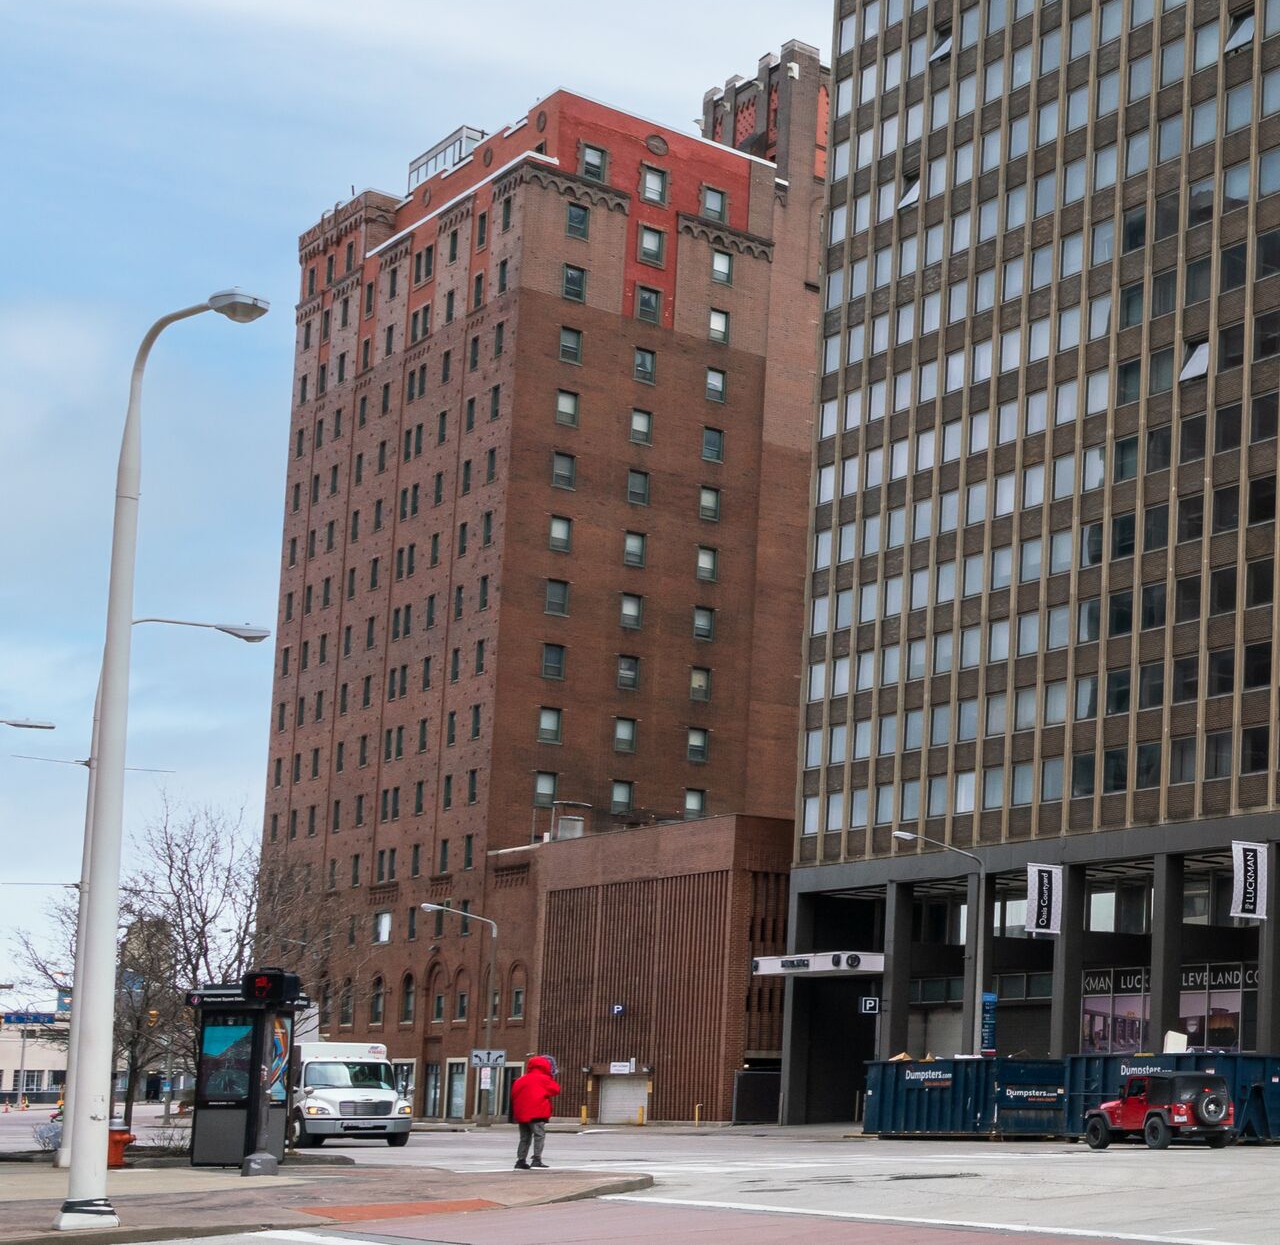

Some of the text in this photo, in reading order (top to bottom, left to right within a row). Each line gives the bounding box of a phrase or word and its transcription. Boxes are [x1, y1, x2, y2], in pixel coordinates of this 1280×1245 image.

[1246, 852, 1255, 903] LUCKMAN
[1039, 872, 1050, 926] Oasis Courtyard
[614, 1005, 622, 1013] P
[866, 1000, 875, 1010] P
[1006, 1088, 1057, 1098] Dumpsters.com
